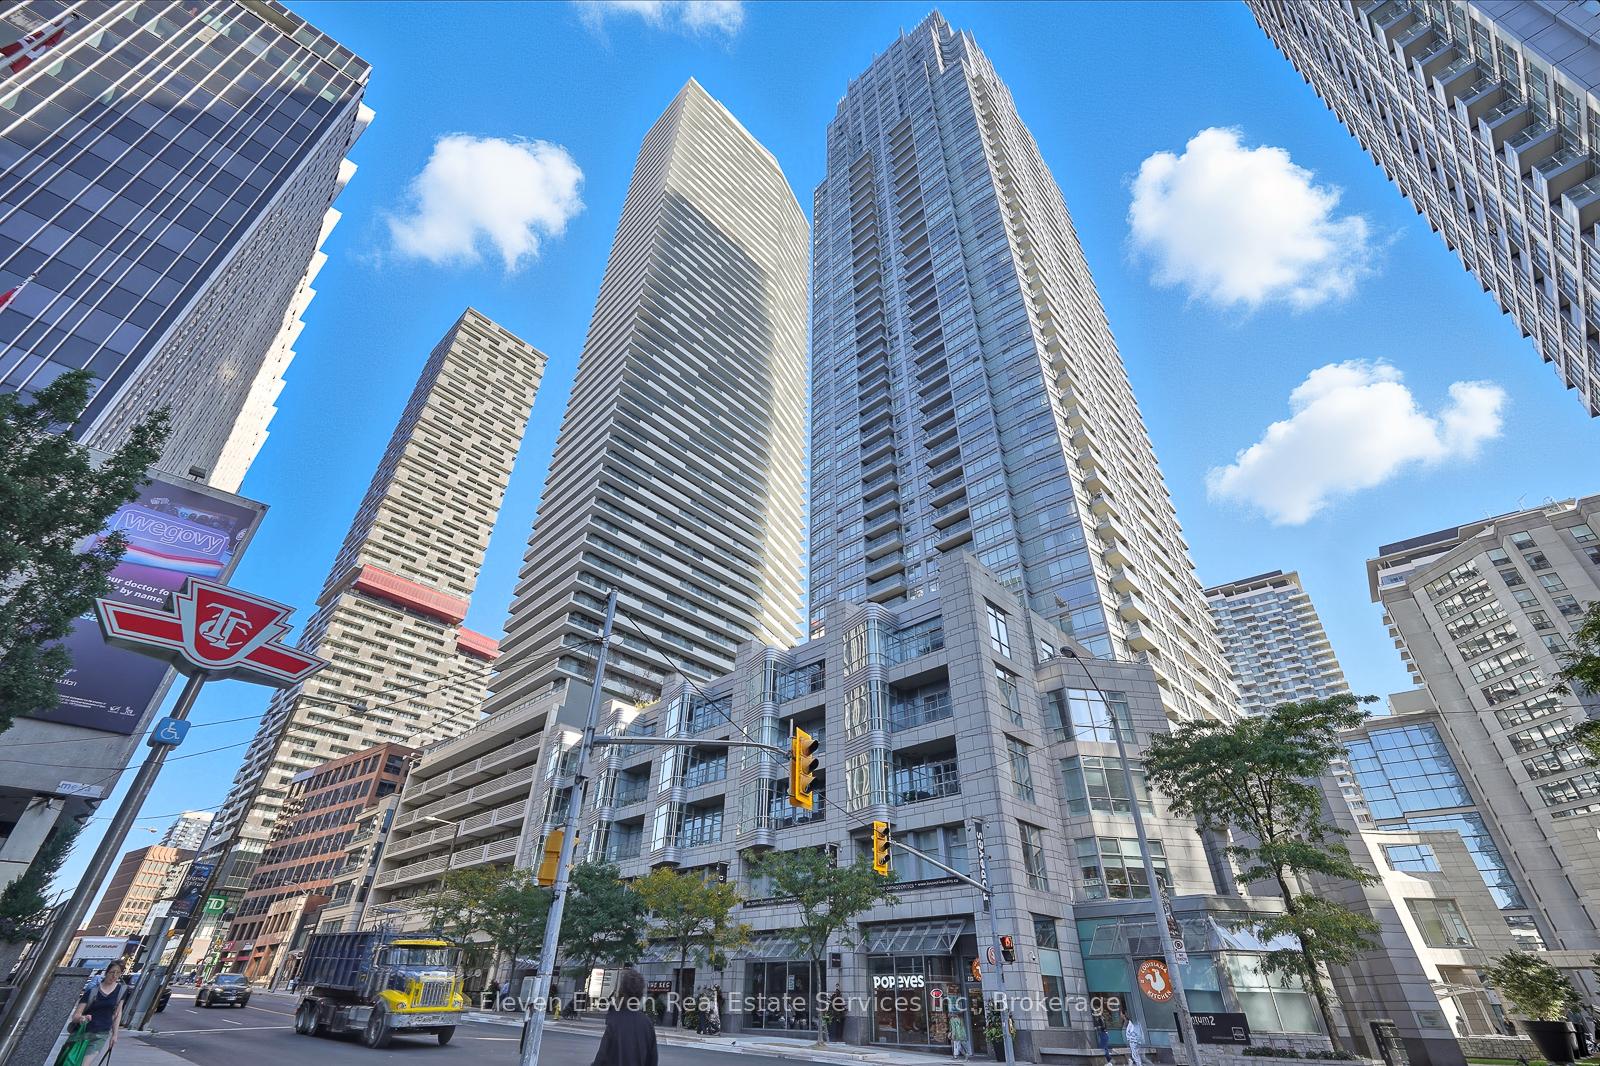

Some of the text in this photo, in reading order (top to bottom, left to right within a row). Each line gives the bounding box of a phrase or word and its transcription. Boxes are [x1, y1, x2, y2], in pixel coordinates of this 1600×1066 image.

[125, 580, 157, 593] doctor
[120, 587, 133, 596] by
[134, 591, 164, 603] name.
[208, 898, 225, 910] TD
[1141, 962, 1168, 973] LOUISIANA
[1147, 990, 1172, 1000] KITCHEN
